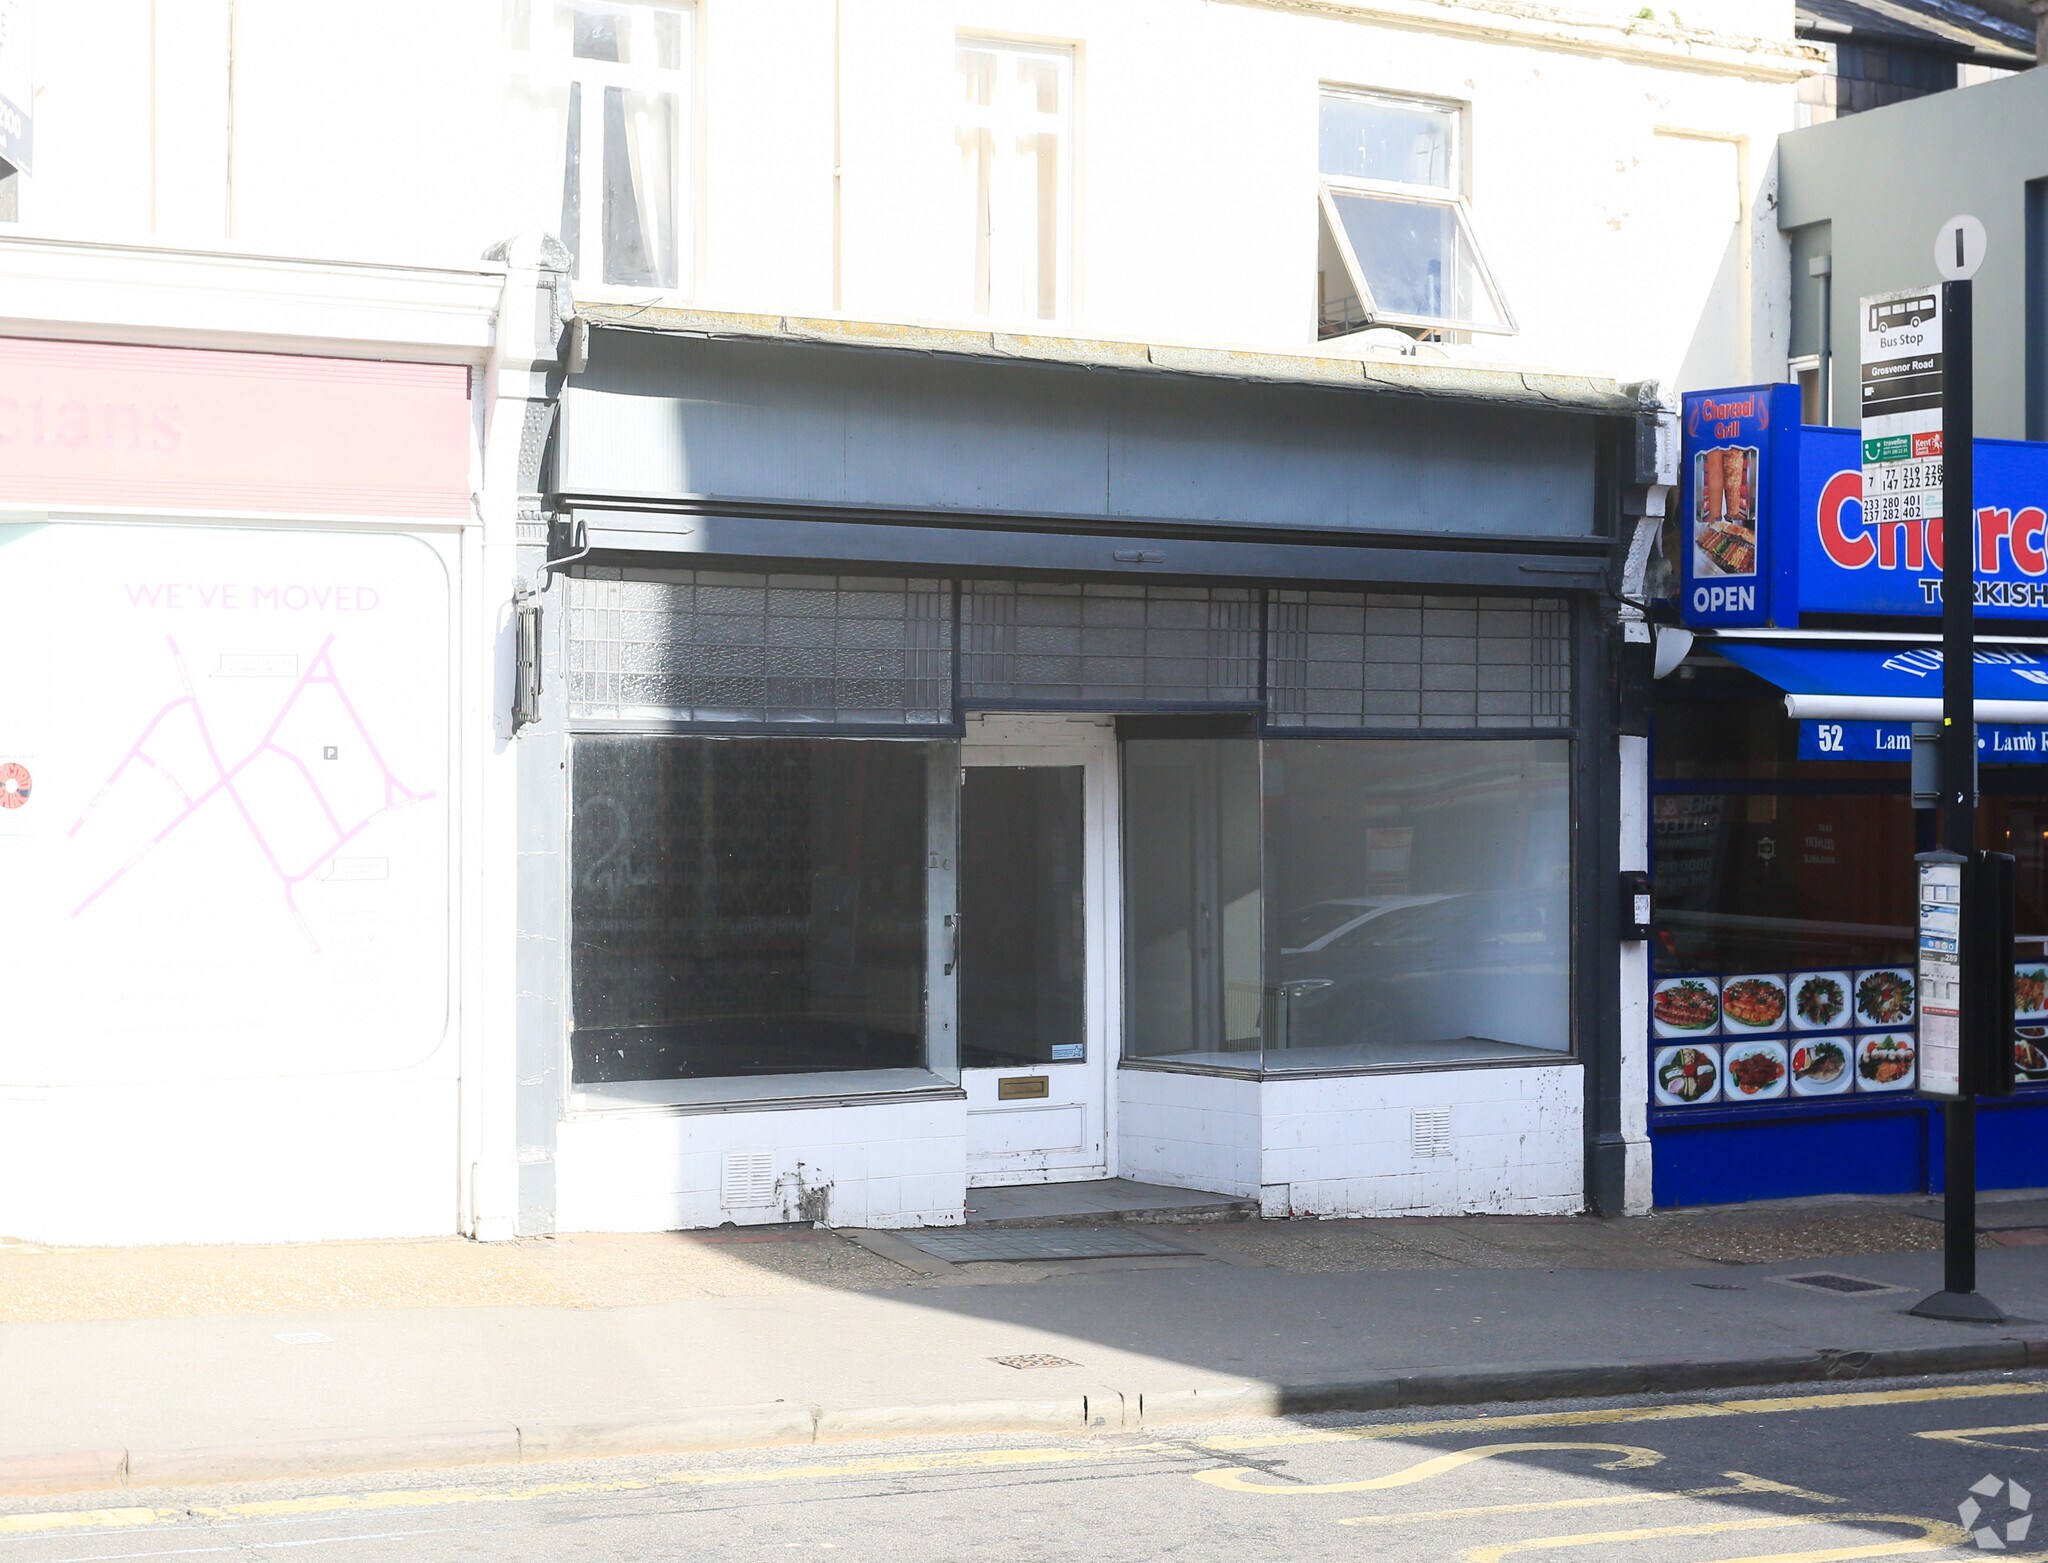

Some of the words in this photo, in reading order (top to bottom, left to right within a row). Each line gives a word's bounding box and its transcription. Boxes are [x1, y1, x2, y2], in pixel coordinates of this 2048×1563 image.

[1880, 337, 1898, 349] Bus
[1900, 333, 1924, 348] Stop
[1871, 363, 1911, 377] Grosvenor
[1912, 358, 1934, 371] Road
[1702, 394, 1755, 421] Charcoal
[1713, 420, 1740, 440] Grill
[1915, 438, 1931, 447] Kent
[1885, 469, 1896, 480] 77
[1903, 467, 1920, 478] 219
[1925, 465, 1943, 476] 228
[1868, 477, 1874, 488] 7
[1882, 480, 1898, 491] 147
[1903, 478, 1921, 489] 222
[1925, 476, 1943, 487] 229
[1863, 500, 1880, 511] 233
[1882, 498, 1899, 509] 280
[1903, 495, 1921, 507] 401
[1863, 510, 1880, 522] 237
[1882, 508, 1899, 519] 282
[1903, 506, 1921, 518] 402
[125, 583, 239, 611] WE'VE
[252, 585, 379, 612] MOVED
[1692, 585, 1756, 613] OPEN
[1818, 723, 1844, 752] 52
[1993, 730, 2036, 752] Lamb
